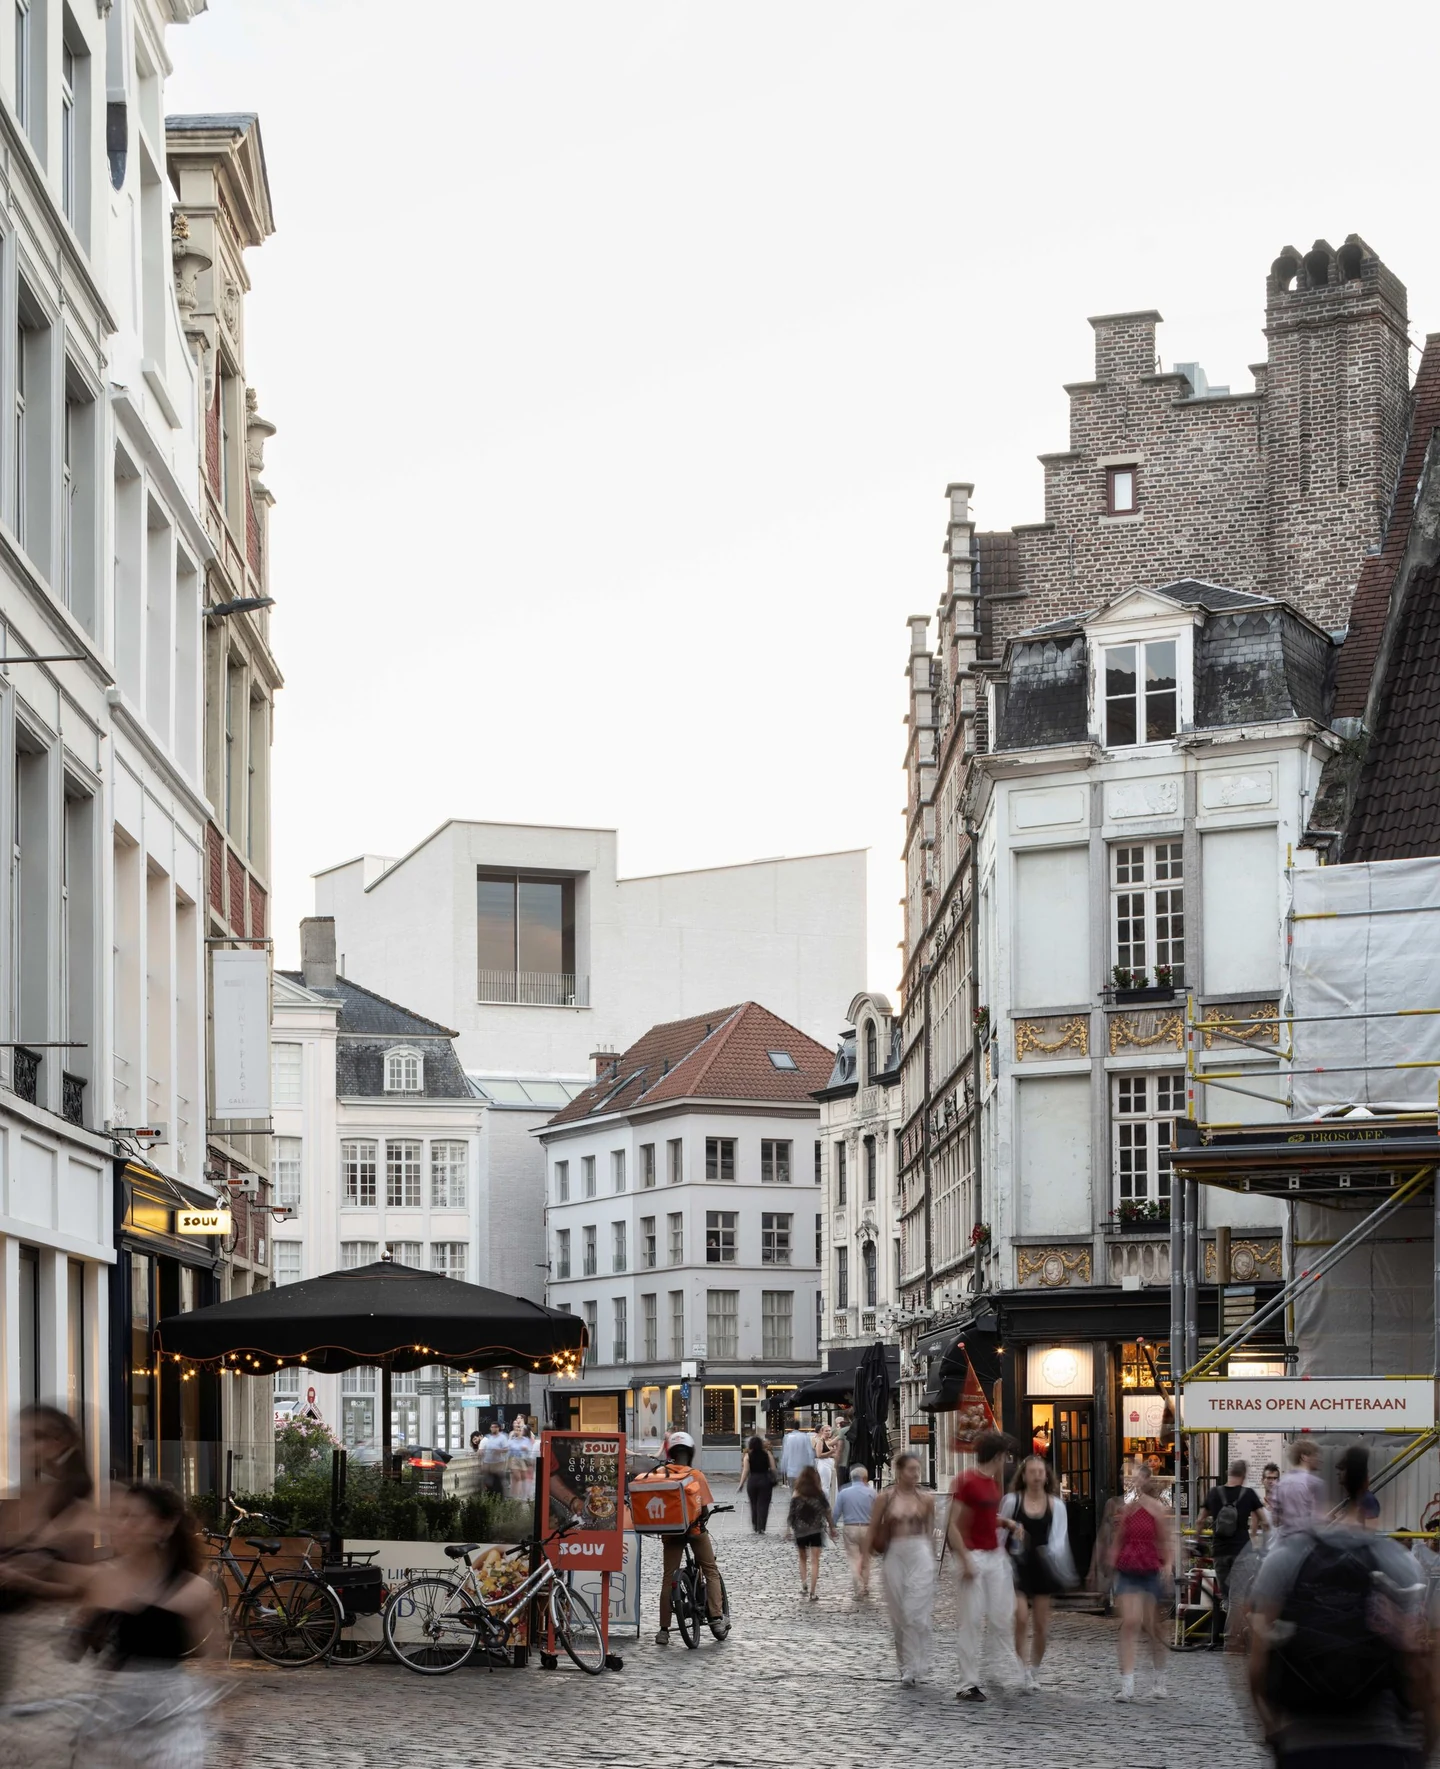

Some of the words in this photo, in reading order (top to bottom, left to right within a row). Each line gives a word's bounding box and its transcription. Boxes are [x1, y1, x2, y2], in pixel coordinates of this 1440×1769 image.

[184, 1217, 218, 1226] SOUV
[1208, 1399, 1262, 1411] TERRAS
[1265, 1398, 1306, 1411] OPEN
[1309, 1398, 1406, 1411] ACHTERAAN
[585, 1443, 617, 1454] SOUV
[569, 1457, 615, 1466] GREEK
[568, 1465, 615, 1473] GYROS
[585, 1474, 608, 1482] 10.90
[559, 1542, 605, 1556] SOUV
